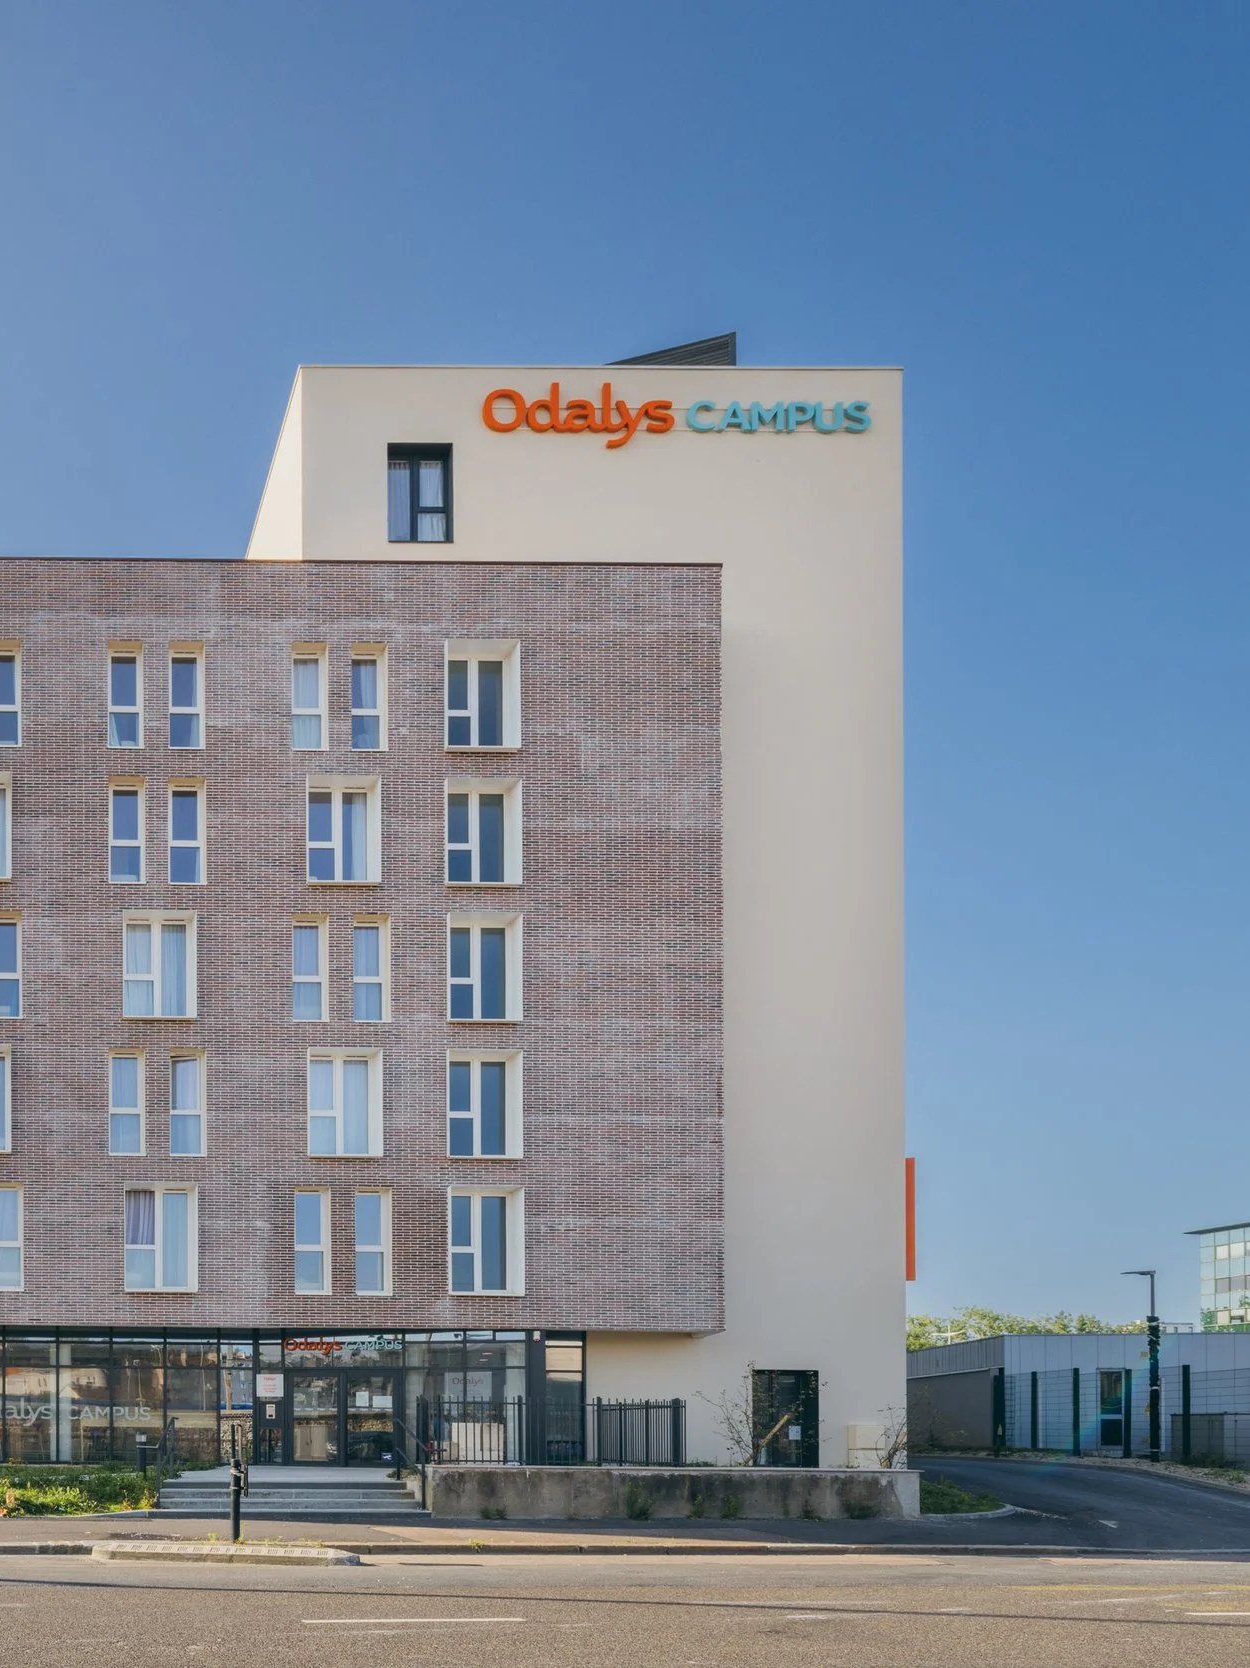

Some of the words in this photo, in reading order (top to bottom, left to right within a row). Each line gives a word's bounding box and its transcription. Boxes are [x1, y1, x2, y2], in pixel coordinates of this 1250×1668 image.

[482, 382, 676, 449] Odalys
[685, 399, 872, 434] CAMPUS
[283, 1335, 343, 1355] Odalys
[345, 1340, 403, 1351] CAMPUS
[67, 1406, 151, 1421] CAMPUS
